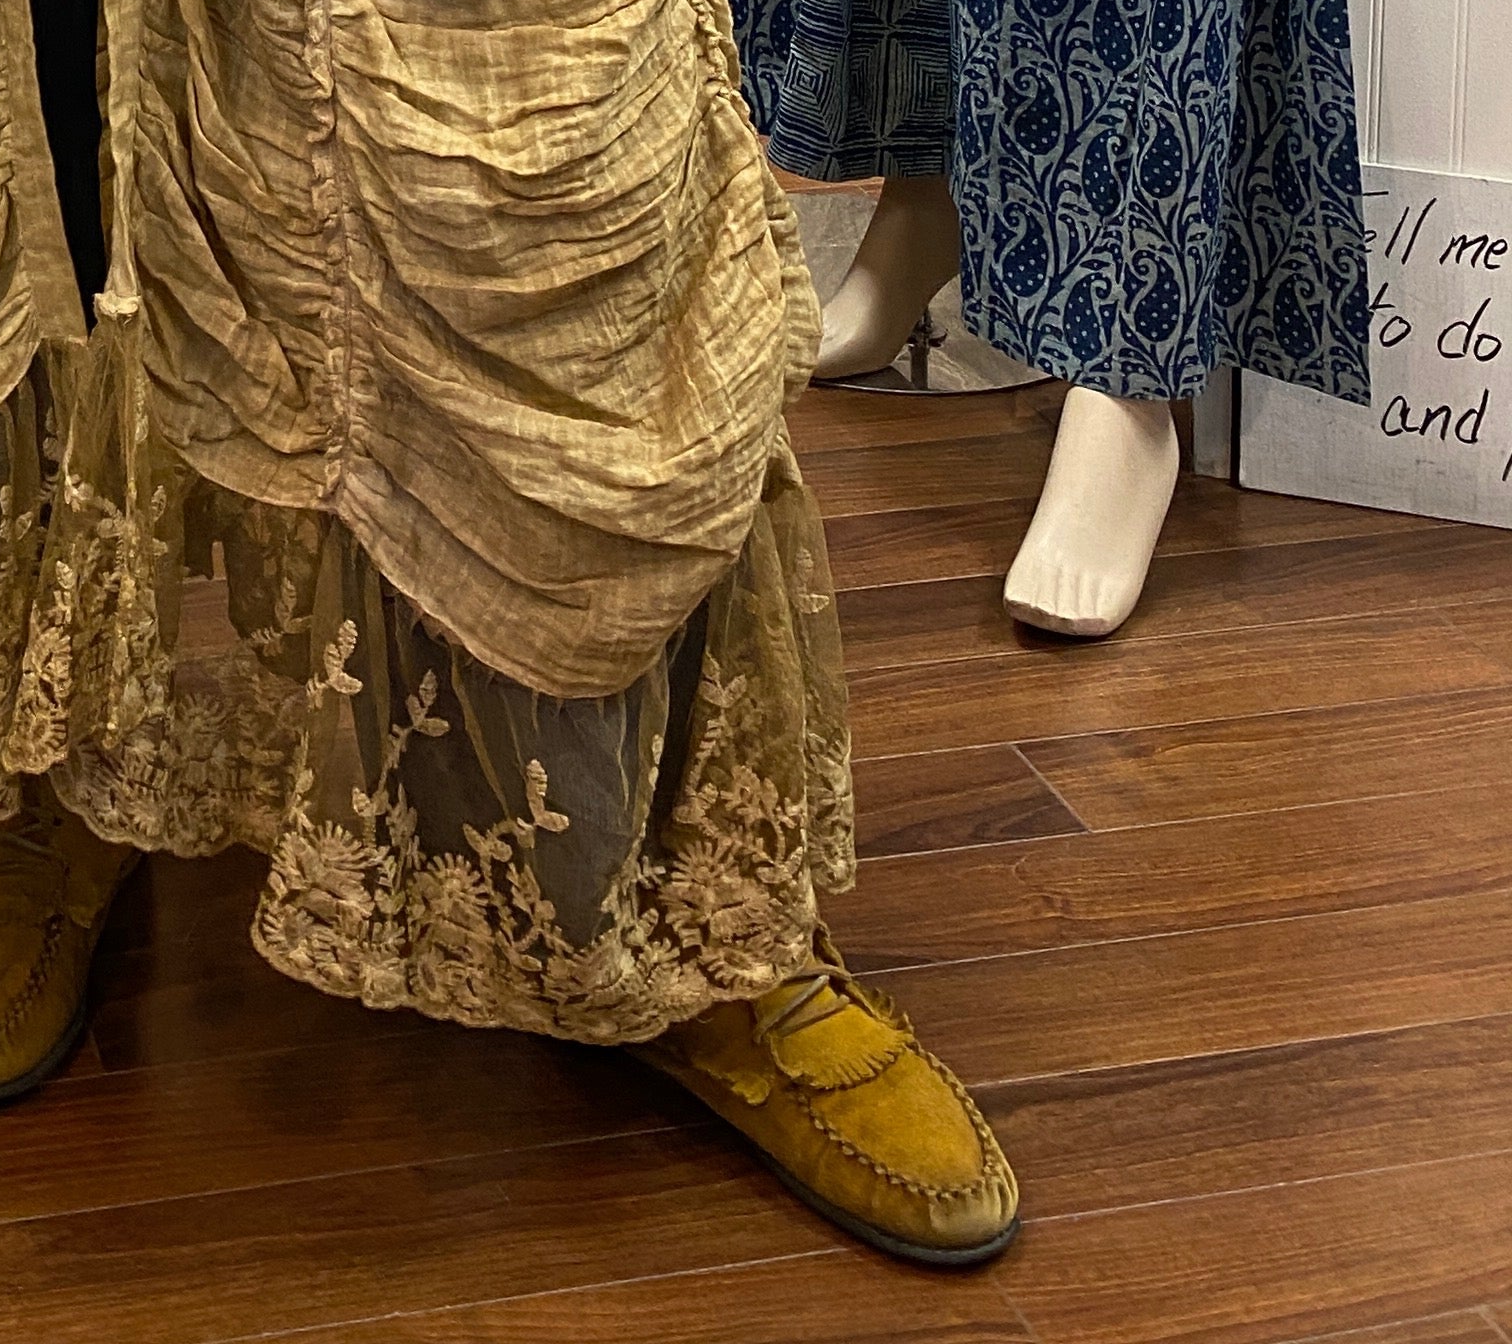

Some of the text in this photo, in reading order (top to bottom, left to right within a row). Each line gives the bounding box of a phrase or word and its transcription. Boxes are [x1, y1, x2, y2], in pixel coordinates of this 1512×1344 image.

[1439, 234, 1509, 270] me
[1437, 297, 1502, 362] do
[1381, 388, 1490, 444] and
